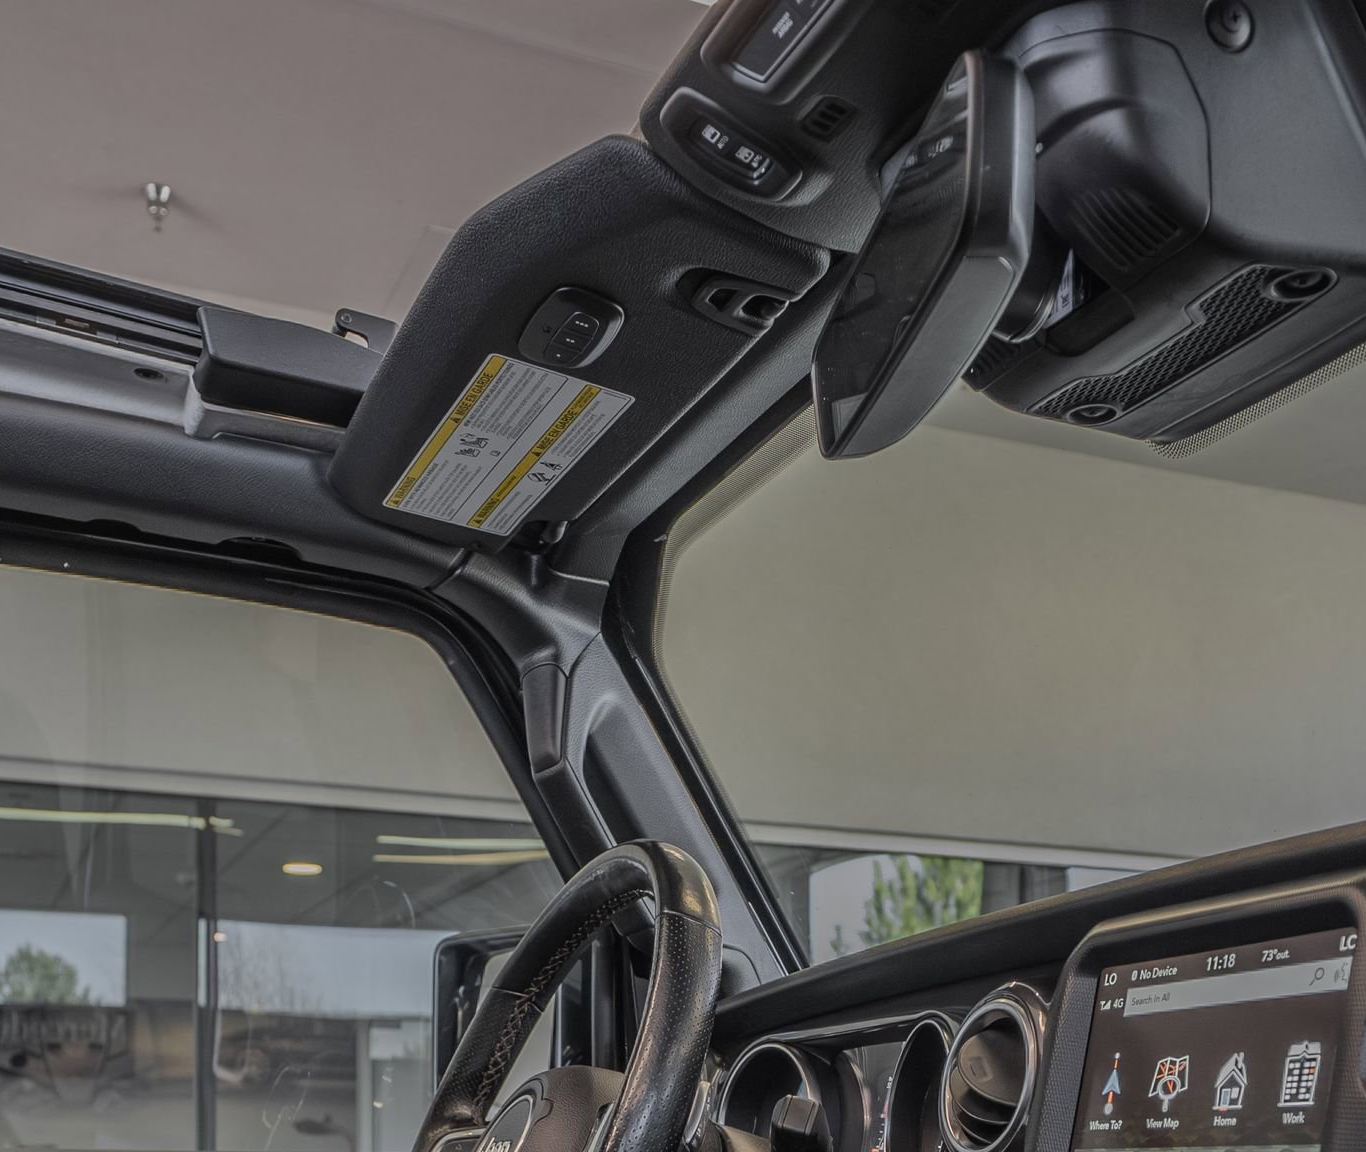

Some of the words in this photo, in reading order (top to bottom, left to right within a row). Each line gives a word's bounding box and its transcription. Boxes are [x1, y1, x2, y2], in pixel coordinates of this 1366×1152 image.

[470, 372, 493, 393] GARDE
[464, 392, 478, 403] EN
[454, 402, 471, 416] MISE
[535, 436, 554, 450] MISE
[547, 427, 562, 437] EN
[1206, 953, 1236, 971] 11:18
[1104, 972, 1117, 986] LO
[1139, 970, 1152, 981] No
[1152, 966, 1178, 979] Device
[1112, 998, 1124, 1009] 4G
[1131, 995, 1152, 1007] Search
[1146, 1118, 1162, 1129] View
[1163, 1118, 1180, 1130] Map
[1213, 1115, 1237, 1127] Home
[1282, 1111, 1306, 1125] Work
[1089, 1120, 1110, 1131] Where
[1110, 1120, 1123, 1131] To?
